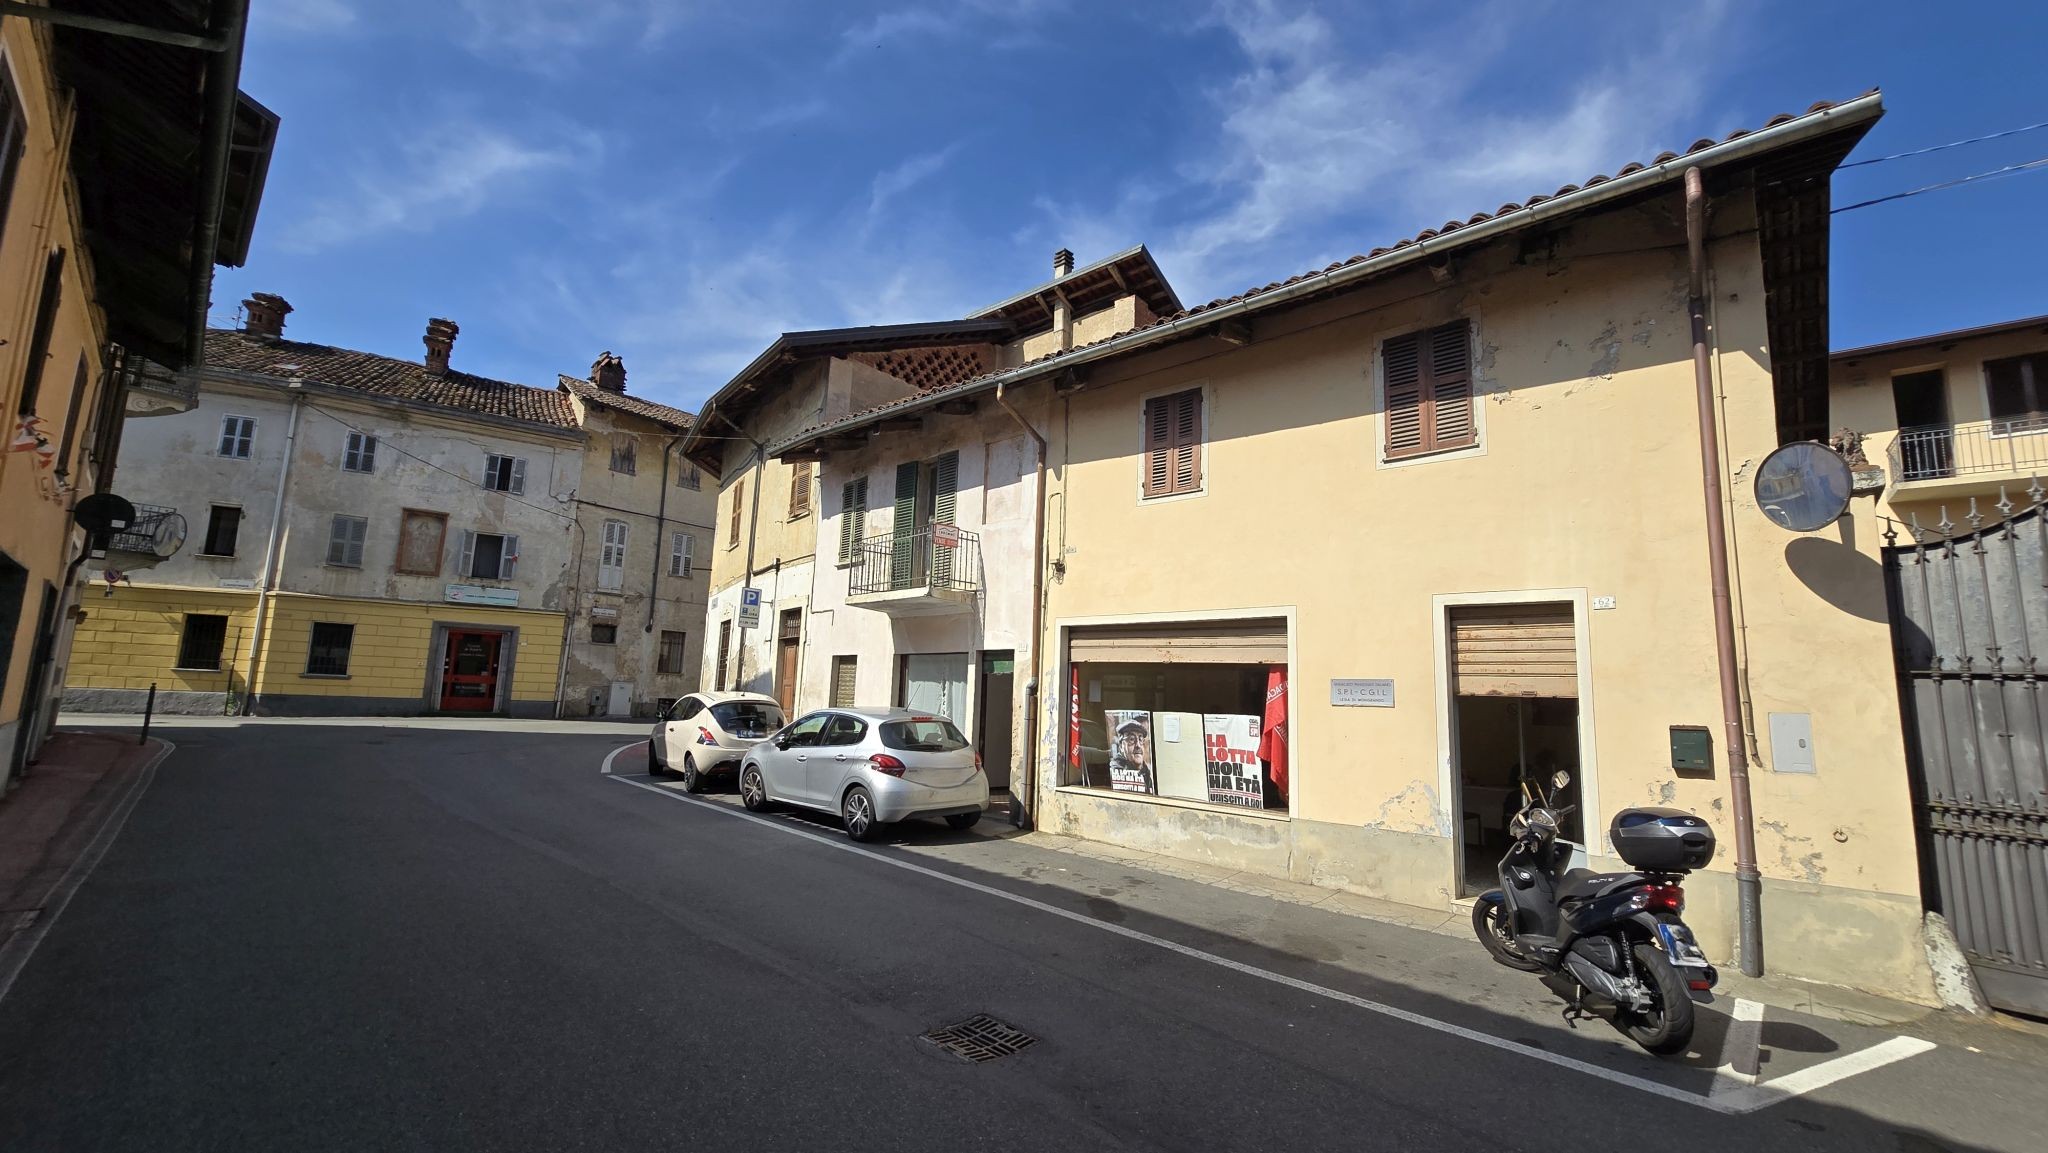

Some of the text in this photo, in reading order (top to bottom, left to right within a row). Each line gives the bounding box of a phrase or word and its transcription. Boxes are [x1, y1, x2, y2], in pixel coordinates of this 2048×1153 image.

[747, 591, 757, 603] P
[1206, 734, 1228, 747] LA
[1207, 748, 1256, 765] LOTTA
[1208, 761, 1244, 777] NON
[1209, 774, 1262, 795] HA ETÀ
[1210, 793, 1244, 806] UNISCITI
